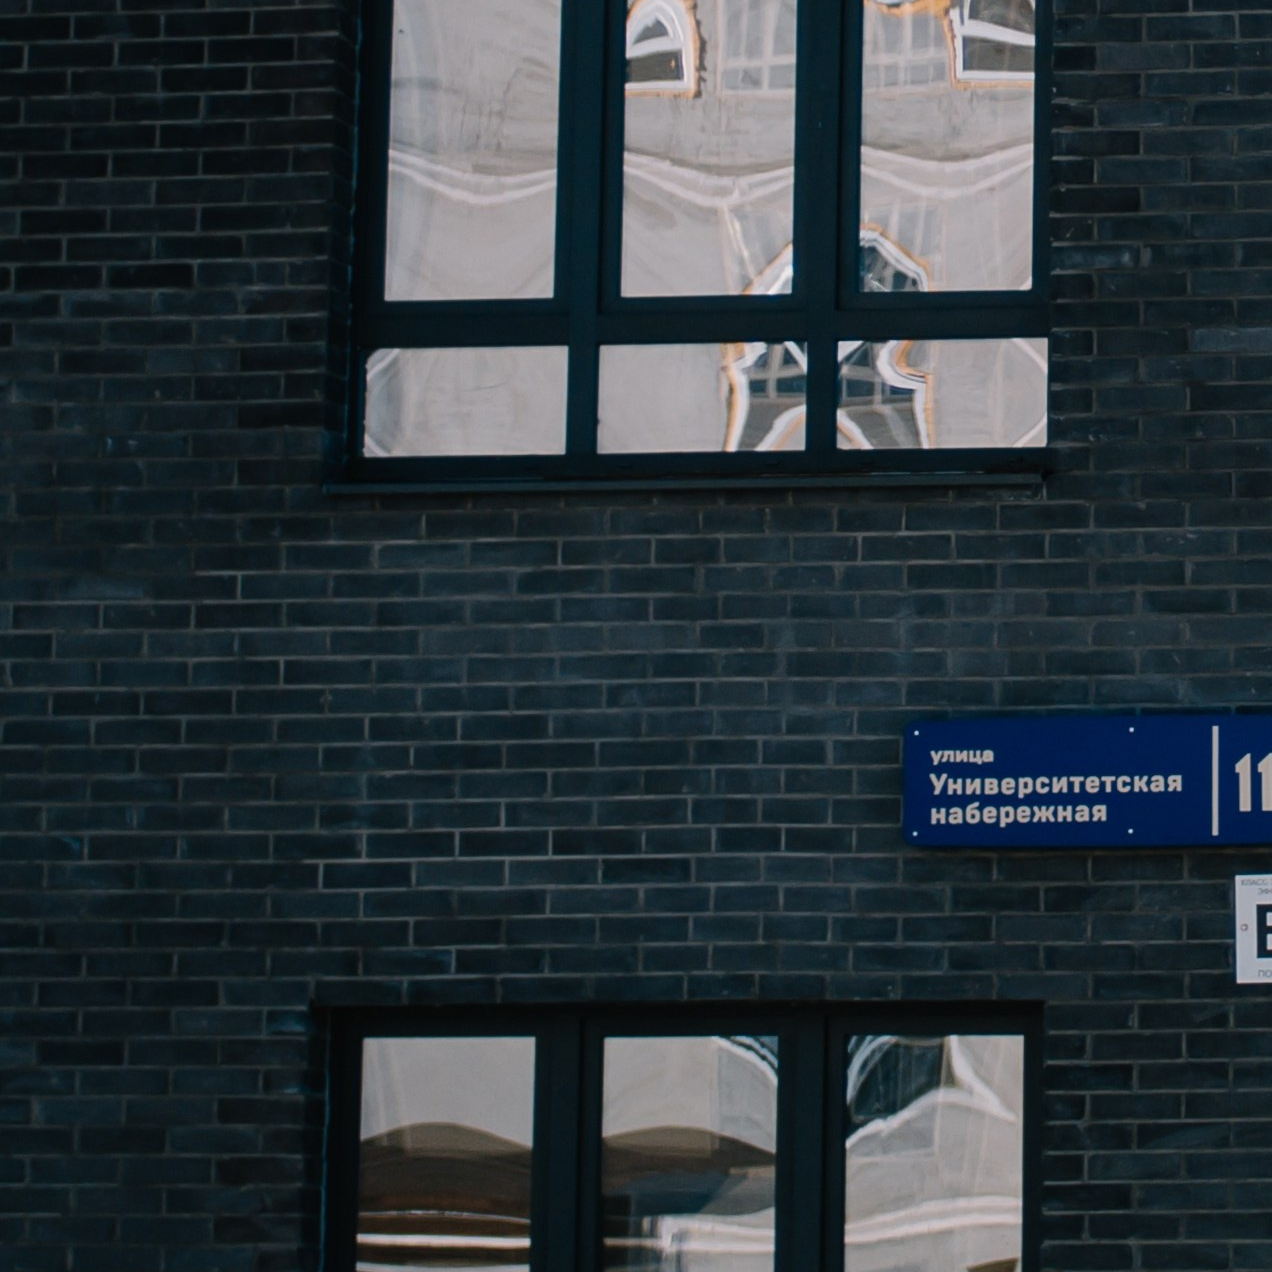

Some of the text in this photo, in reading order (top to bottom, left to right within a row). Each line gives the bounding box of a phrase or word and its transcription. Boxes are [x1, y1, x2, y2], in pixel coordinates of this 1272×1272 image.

[930, 749, 994, 765] улица
[929, 773, 1183, 799] Университетская
[930, 802, 1107, 828] набережная
